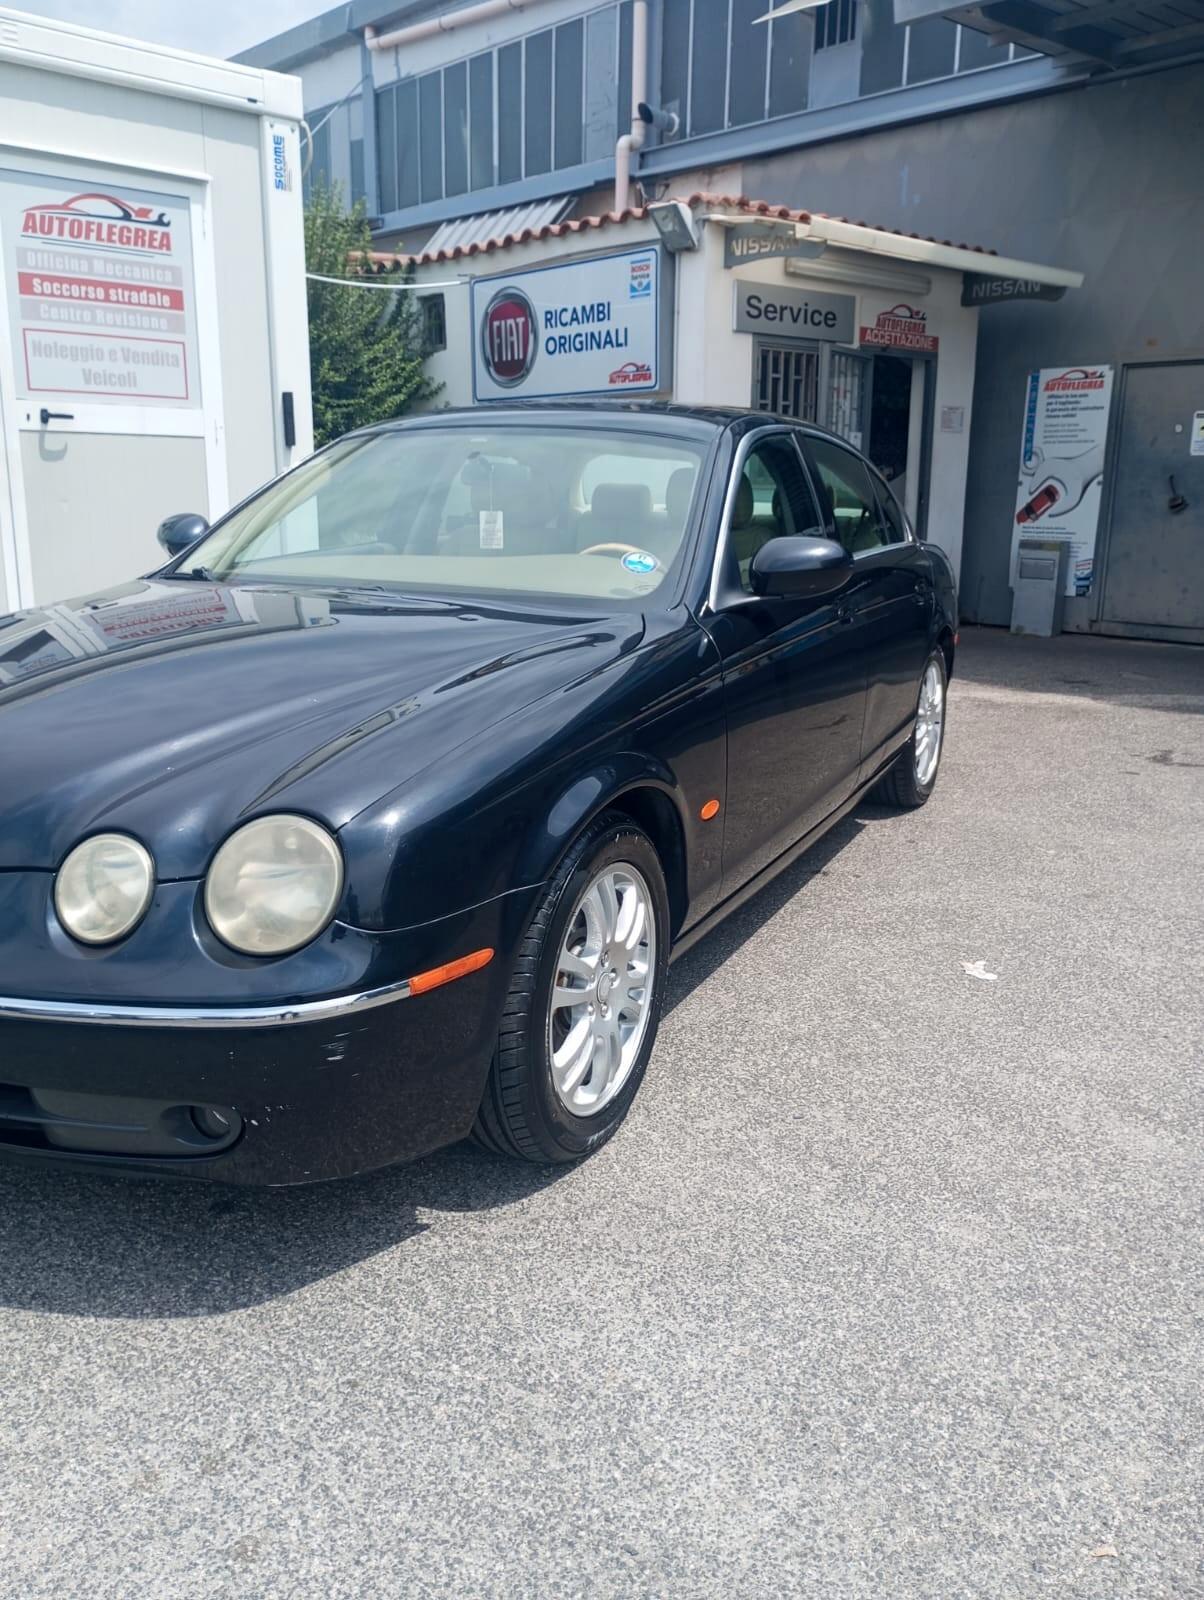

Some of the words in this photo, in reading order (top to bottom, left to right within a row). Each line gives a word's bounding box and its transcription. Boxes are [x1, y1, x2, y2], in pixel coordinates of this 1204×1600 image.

[22, 213, 172, 251] AUTOFLEGREA
[27, 251, 88, 273] Officina
[93, 259, 173, 283] Meccanica
[33, 278, 105, 300] Soccorso
[109, 286, 170, 307] stradale
[972, 279, 1040, 298] NISSAN
[40, 303, 91, 322] Centro
[96, 308, 169, 331] Revisione
[544, 301, 611, 329] RICAMBI
[745, 294, 837, 328] Service
[493, 317, 525, 362] FIAT
[545, 328, 628, 355] ORIGINALI
[864, 328, 934, 350] ACCETTAZIONE
[32, 339, 105, 363] Noleggio
[109, 350, 118, 361] e
[120, 346, 180, 368] Vendita
[82, 368, 137, 388] Veicoli
